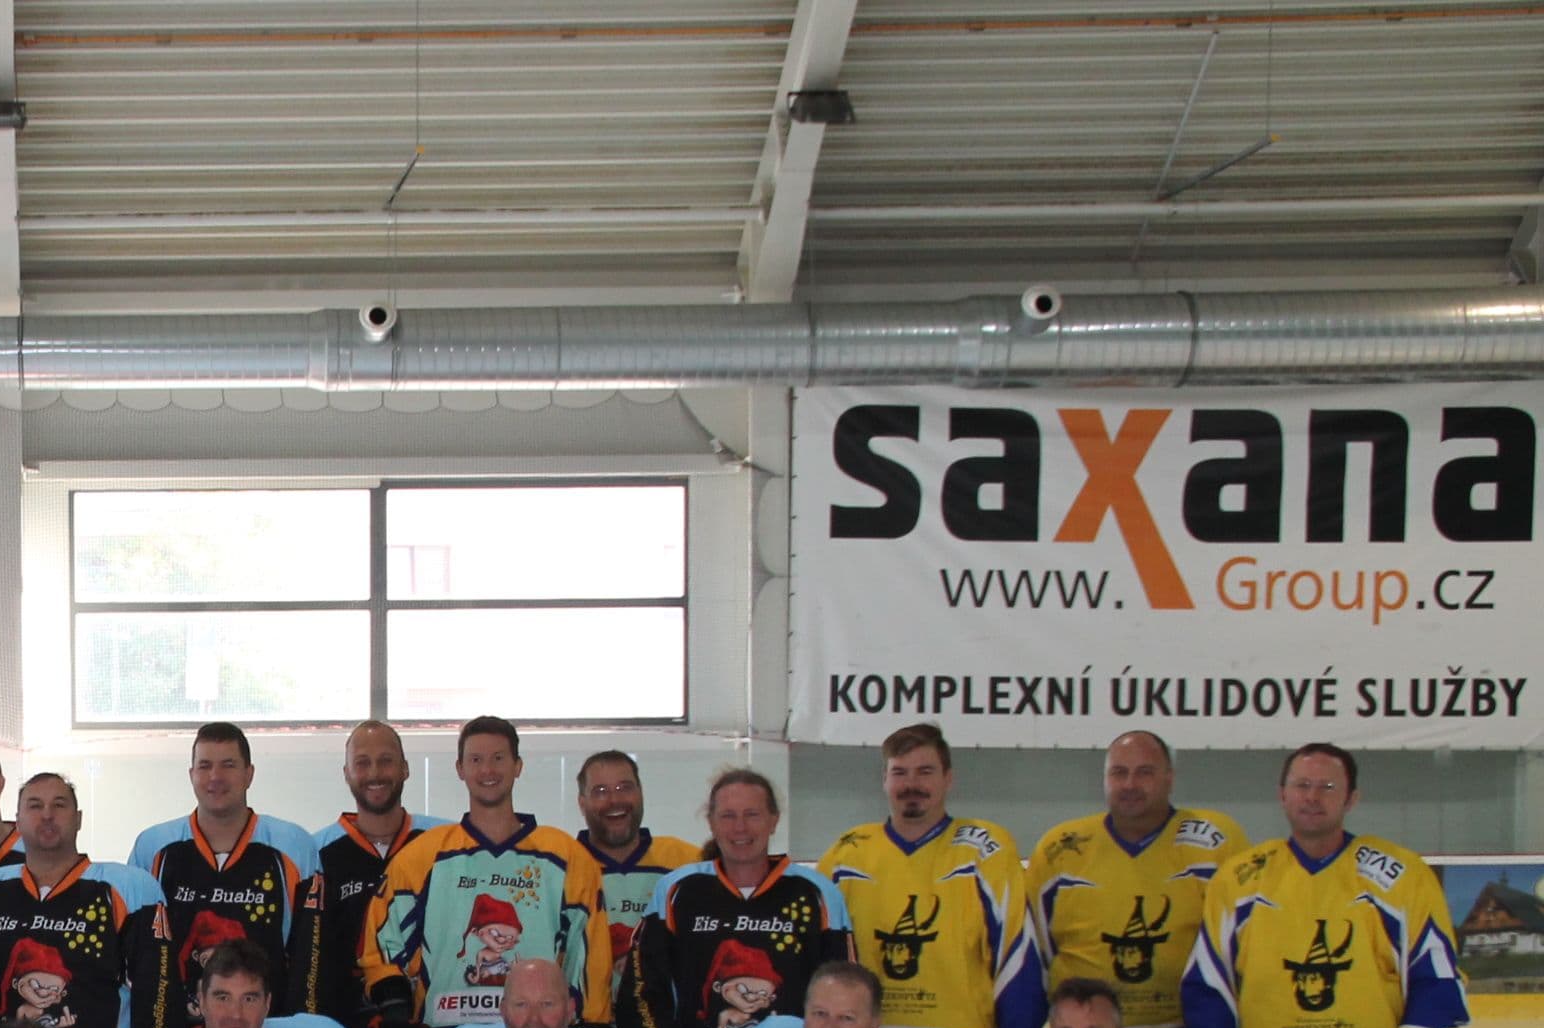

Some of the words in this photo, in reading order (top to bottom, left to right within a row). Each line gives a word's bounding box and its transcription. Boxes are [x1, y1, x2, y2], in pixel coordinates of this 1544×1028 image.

[939, 567, 1125, 610] www.
[1216, 556, 1496, 626] Group.cz
[829, 665, 1093, 716] KOMPLEXNÍ
[1111, 665, 1339, 718] ÚKLIDOVÉ
[1356, 665, 1528, 718] SLUŽBY
[489, 873, 535, 890] Buaba
[210, 888, 265, 904] Buaba
[30, 915, 87, 933] Buaba
[692, 916, 719, 932] Eis
[734, 916, 794, 932] Buaba
[436, 994, 502, 1011] REFUGI
